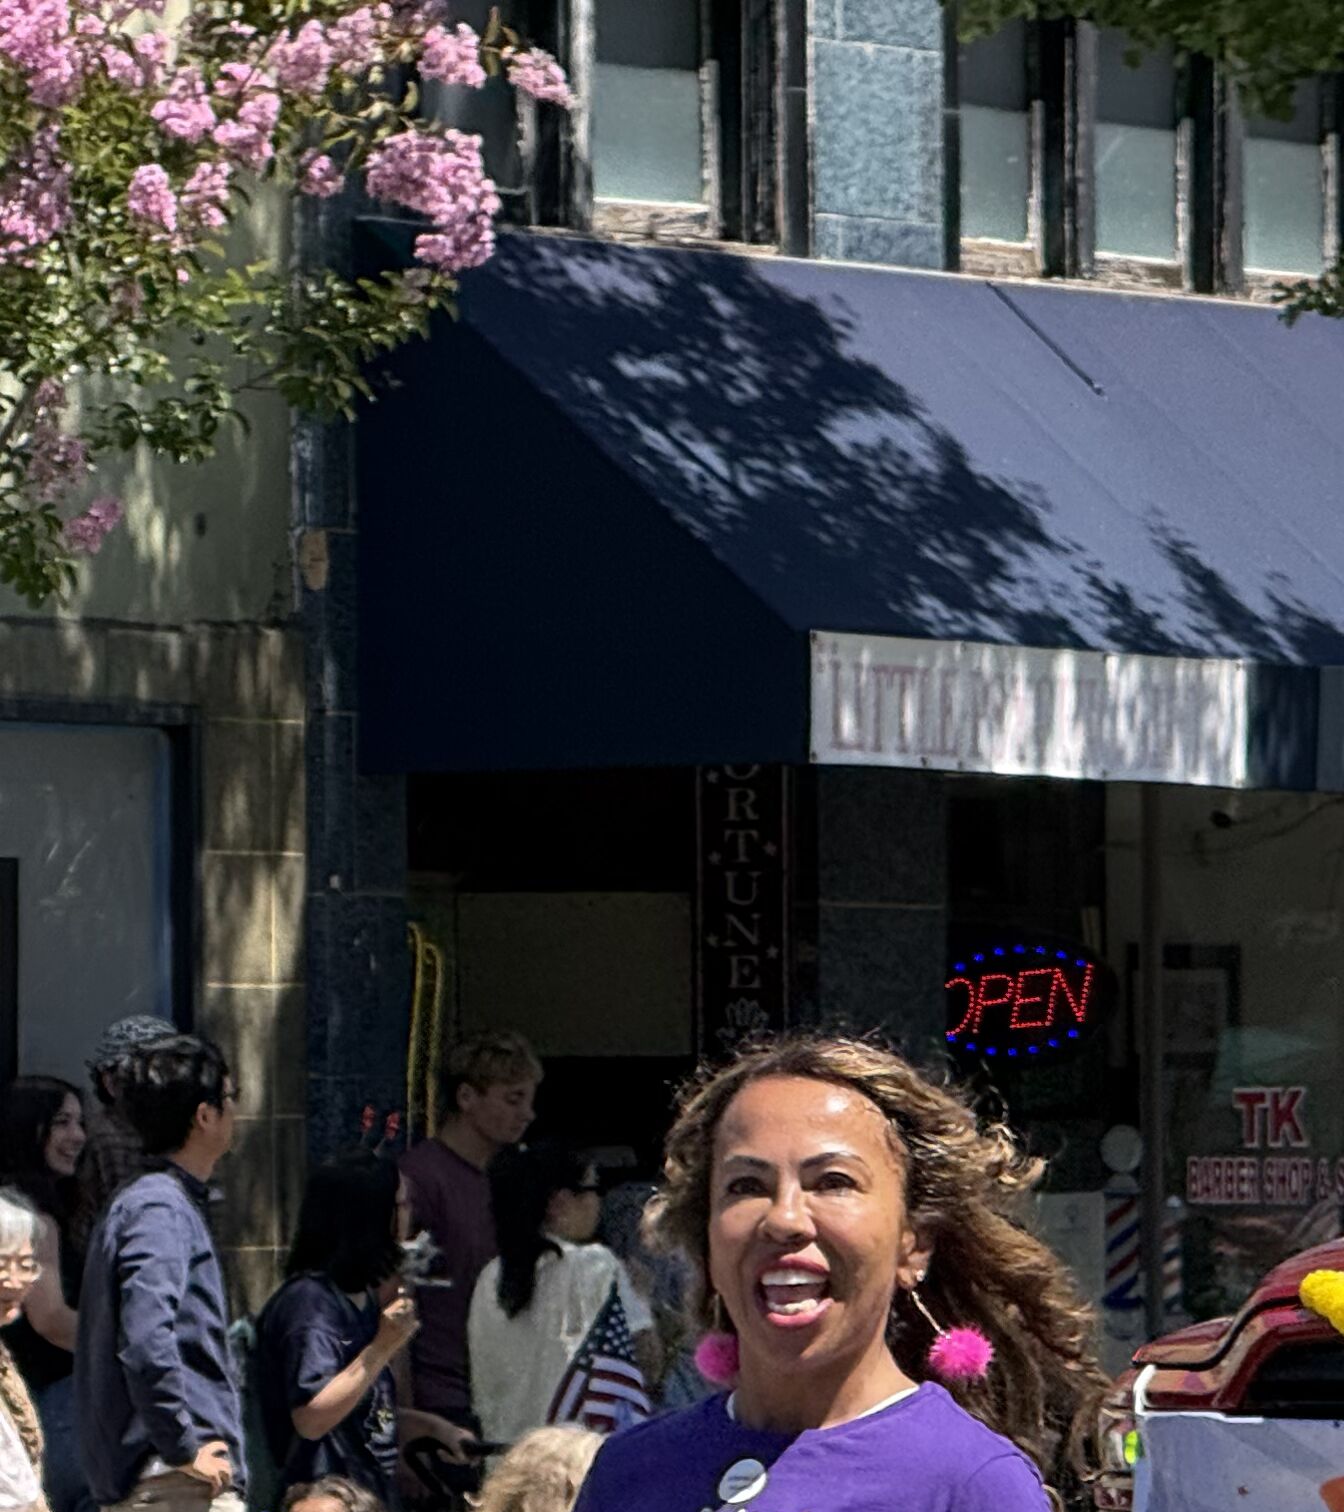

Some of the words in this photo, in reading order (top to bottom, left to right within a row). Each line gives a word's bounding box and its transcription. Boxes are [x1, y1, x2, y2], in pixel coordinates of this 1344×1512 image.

[944, 963, 1094, 1034] OPEN
[1233, 1087, 1310, 1148] TK
[1187, 1155, 1261, 1204] BARBER
[1263, 1156, 1313, 1204] SHOP
